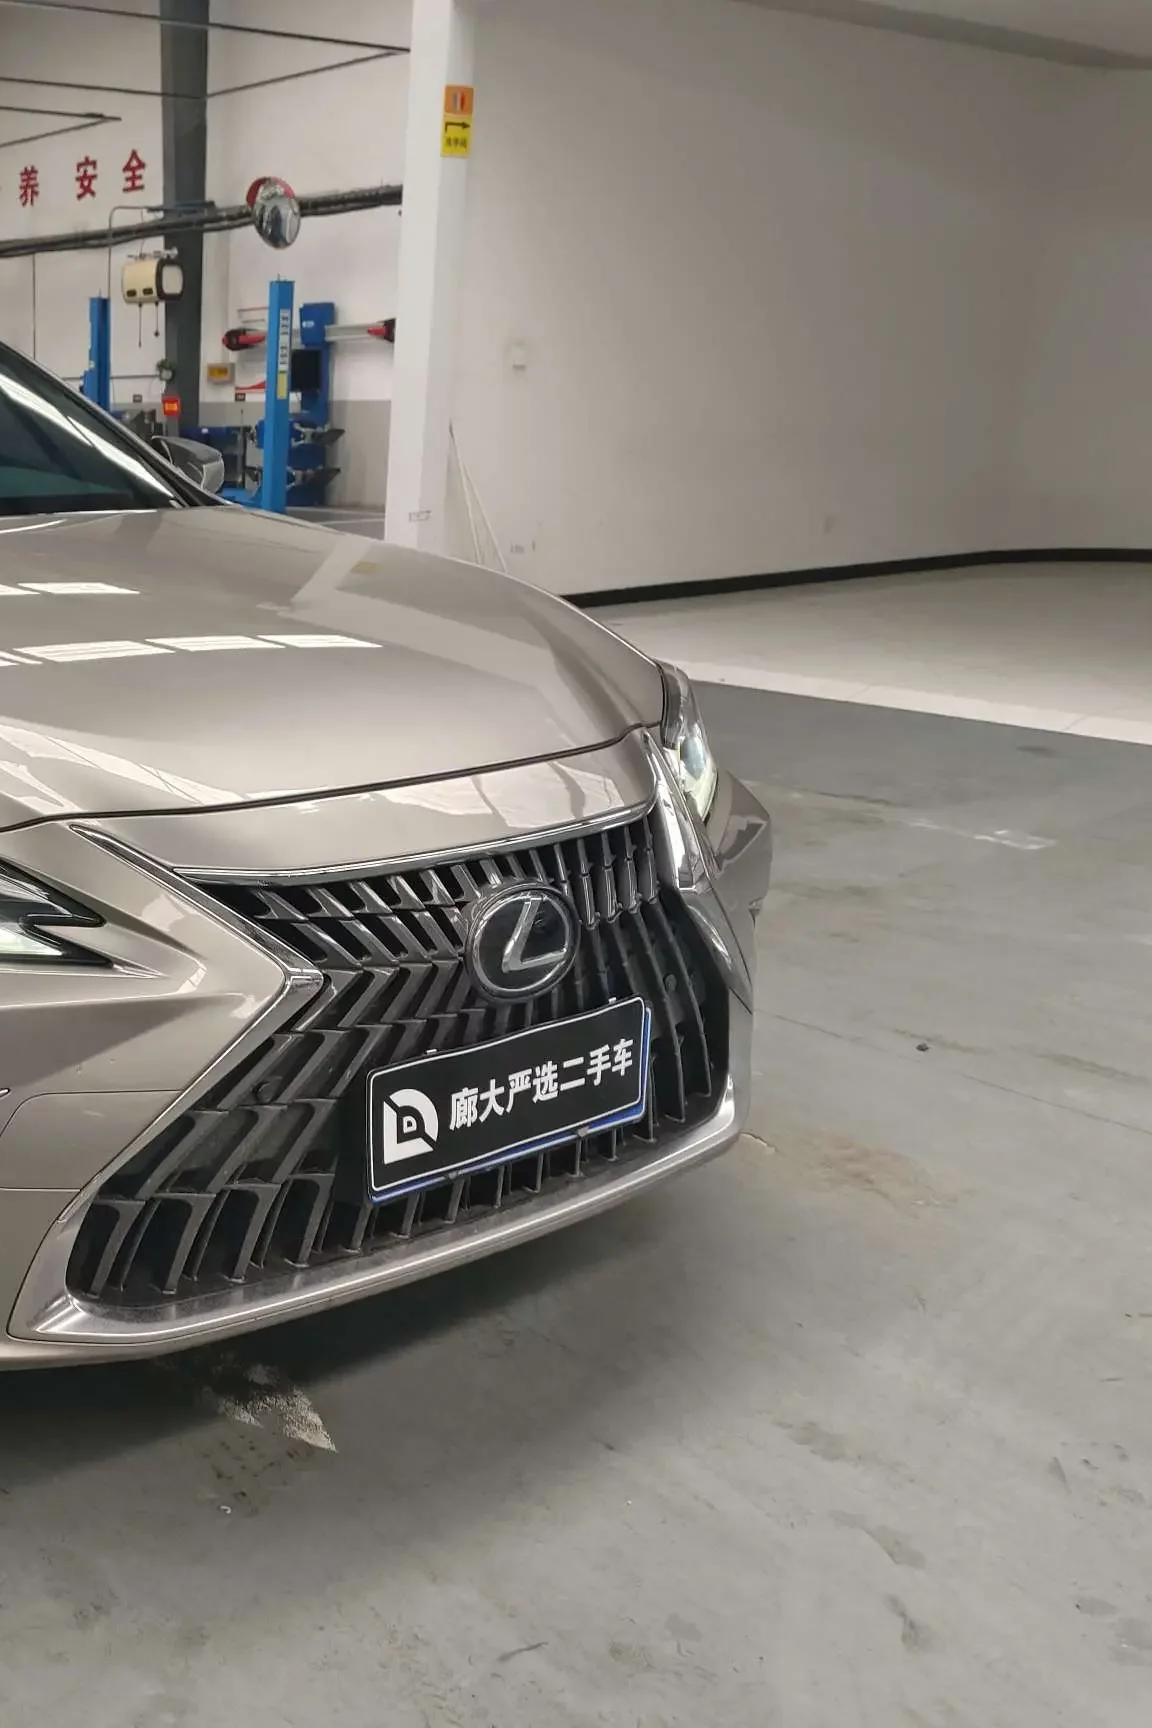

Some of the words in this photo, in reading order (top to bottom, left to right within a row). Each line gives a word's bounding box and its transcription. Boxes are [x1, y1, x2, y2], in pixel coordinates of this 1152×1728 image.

[75, 149, 146, 201] 安全
[449, 1038, 634, 1131] 廊大严选二手车
